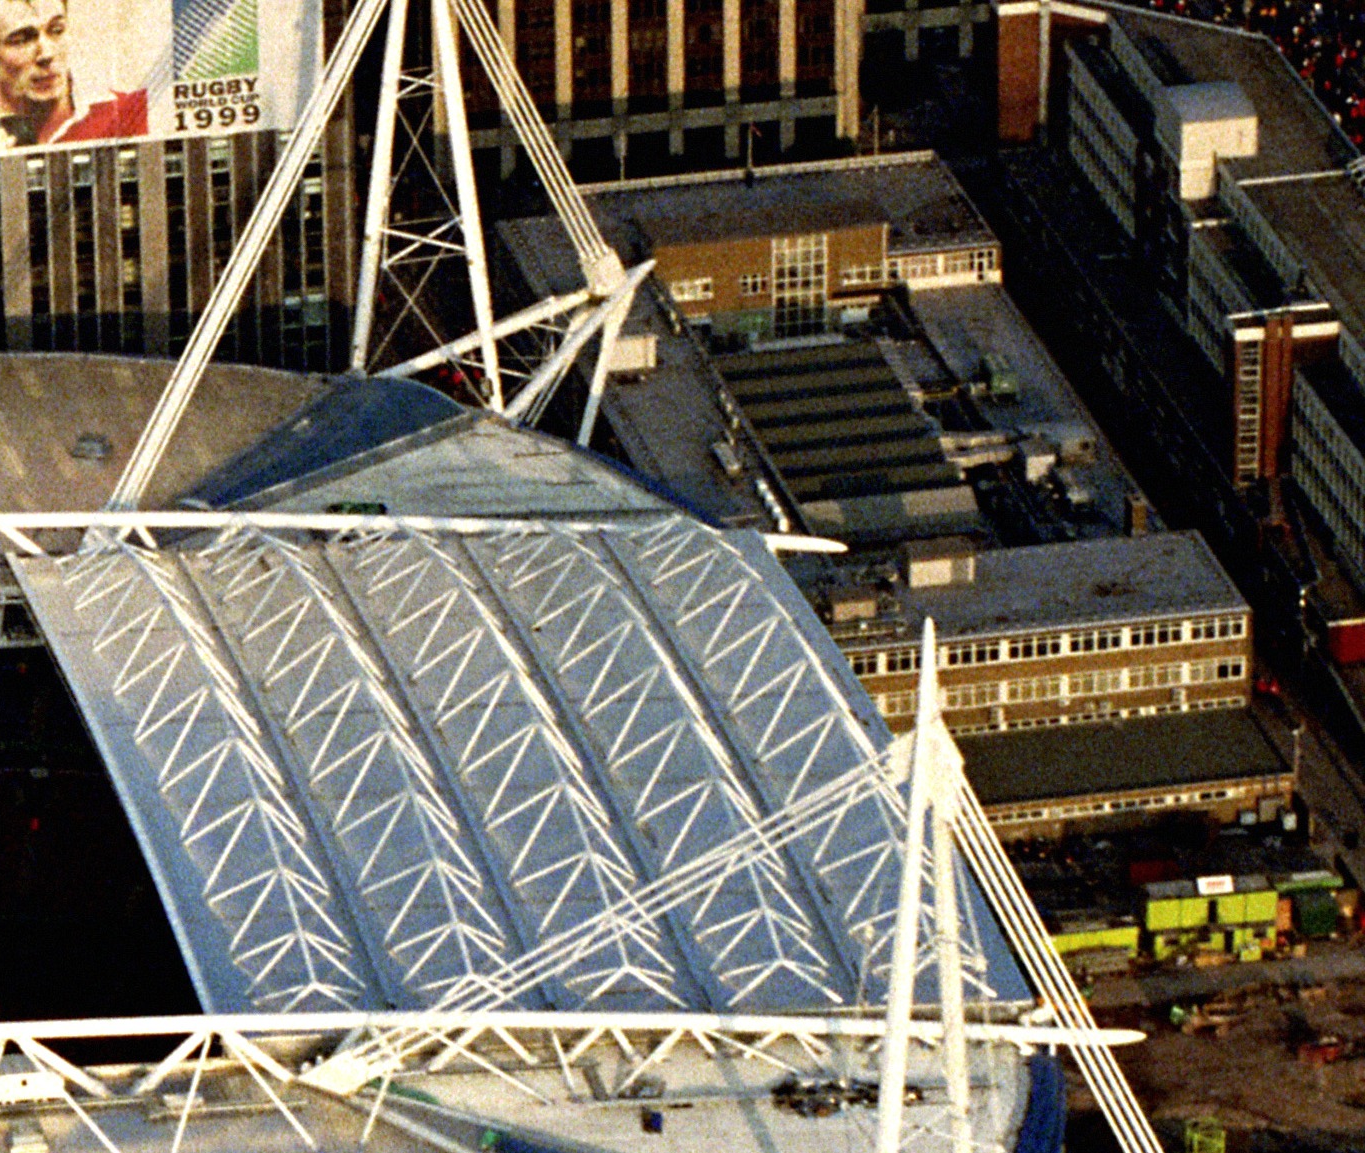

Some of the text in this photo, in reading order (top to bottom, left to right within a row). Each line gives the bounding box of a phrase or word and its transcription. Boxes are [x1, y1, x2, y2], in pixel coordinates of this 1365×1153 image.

[174, 77, 258, 99] RUGBY
[175, 93, 259, 109] WORLD CUP
[175, 104, 260, 131] 1999
